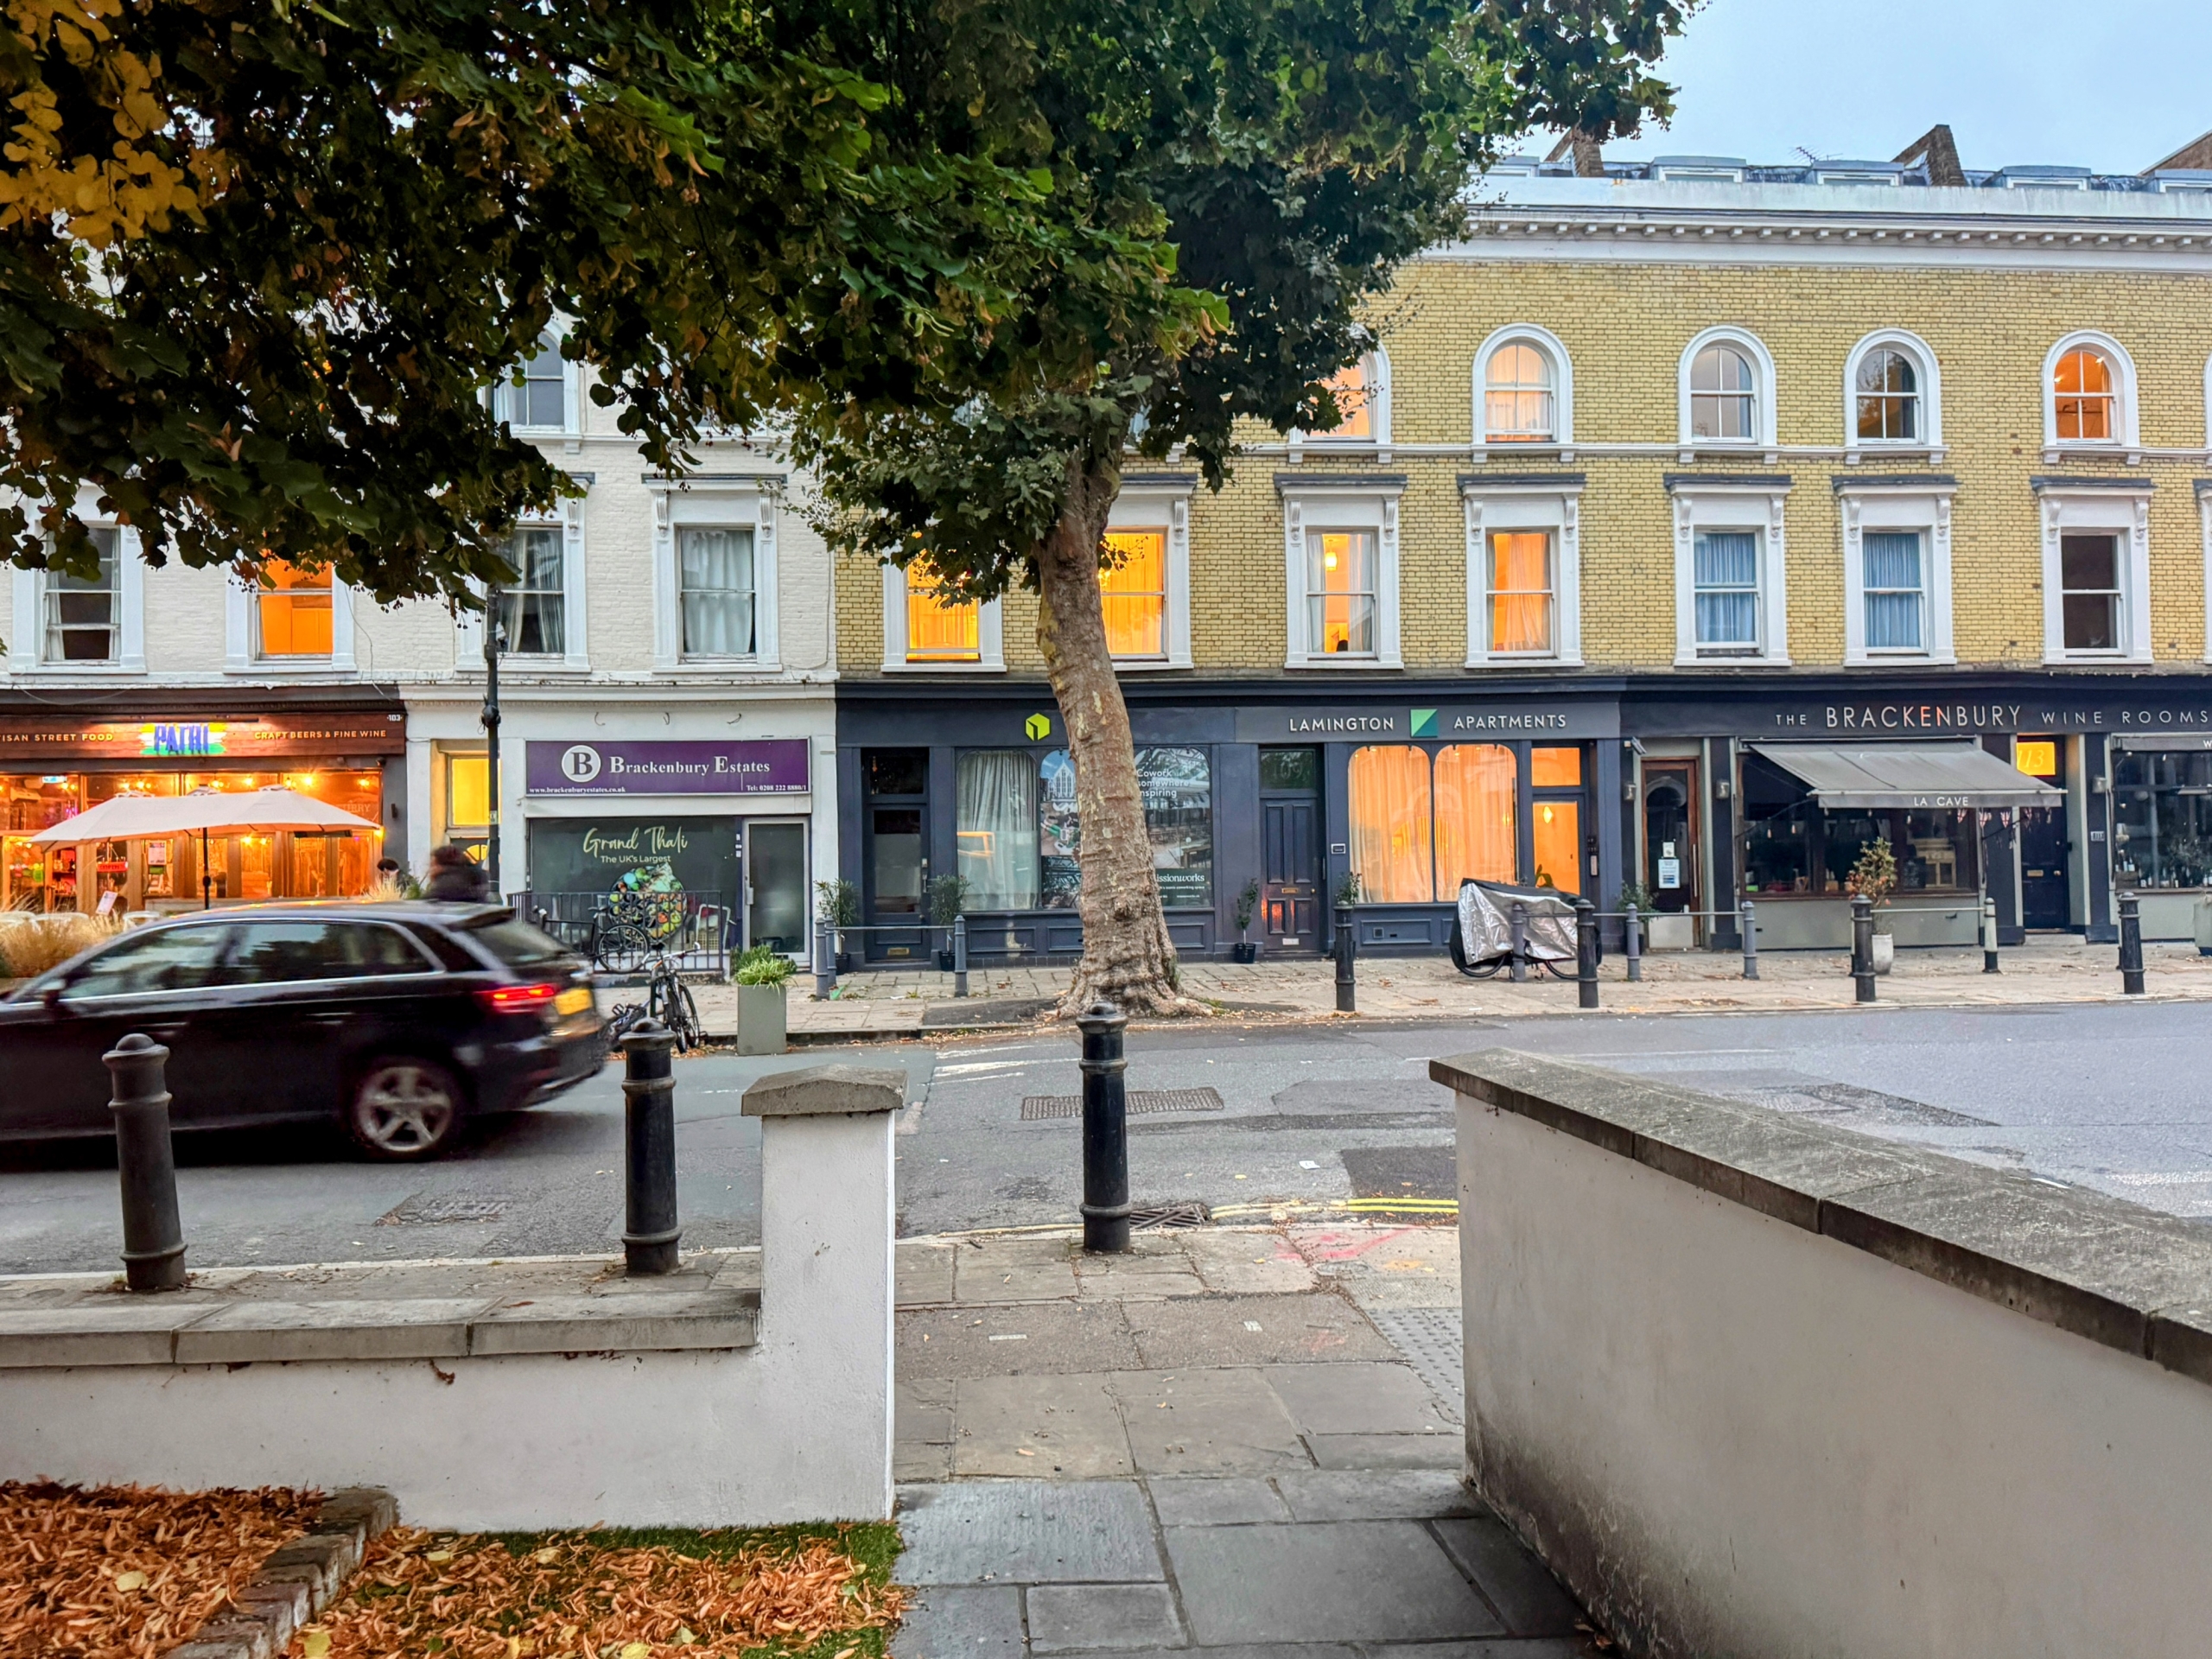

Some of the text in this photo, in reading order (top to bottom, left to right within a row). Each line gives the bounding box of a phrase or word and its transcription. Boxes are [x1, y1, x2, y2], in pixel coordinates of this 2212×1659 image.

[1776, 705, 2209, 728] THE BRACKENBURY WINE ROOMS
[1289, 715, 1567, 732] LAMINGTON APARTMENTS
[0, 734, 29, 742] ISAN
[82, 733, 113, 741] FOOD
[254, 731, 288, 740] CRAFT
[571, 752, 593, 776] B
[608, 755, 771, 776] Brackenbury Estates
[1136, 768, 1172, 778] Cowork
[1140, 789, 1177, 798] nspiring
[1914, 797, 1969, 806] LA CAVE
[582, 825, 688, 858] Grand Thali
[619, 855, 638, 863] UK's
[639, 855, 671, 864] Largest
[1156, 874, 1205, 882] issionworks
